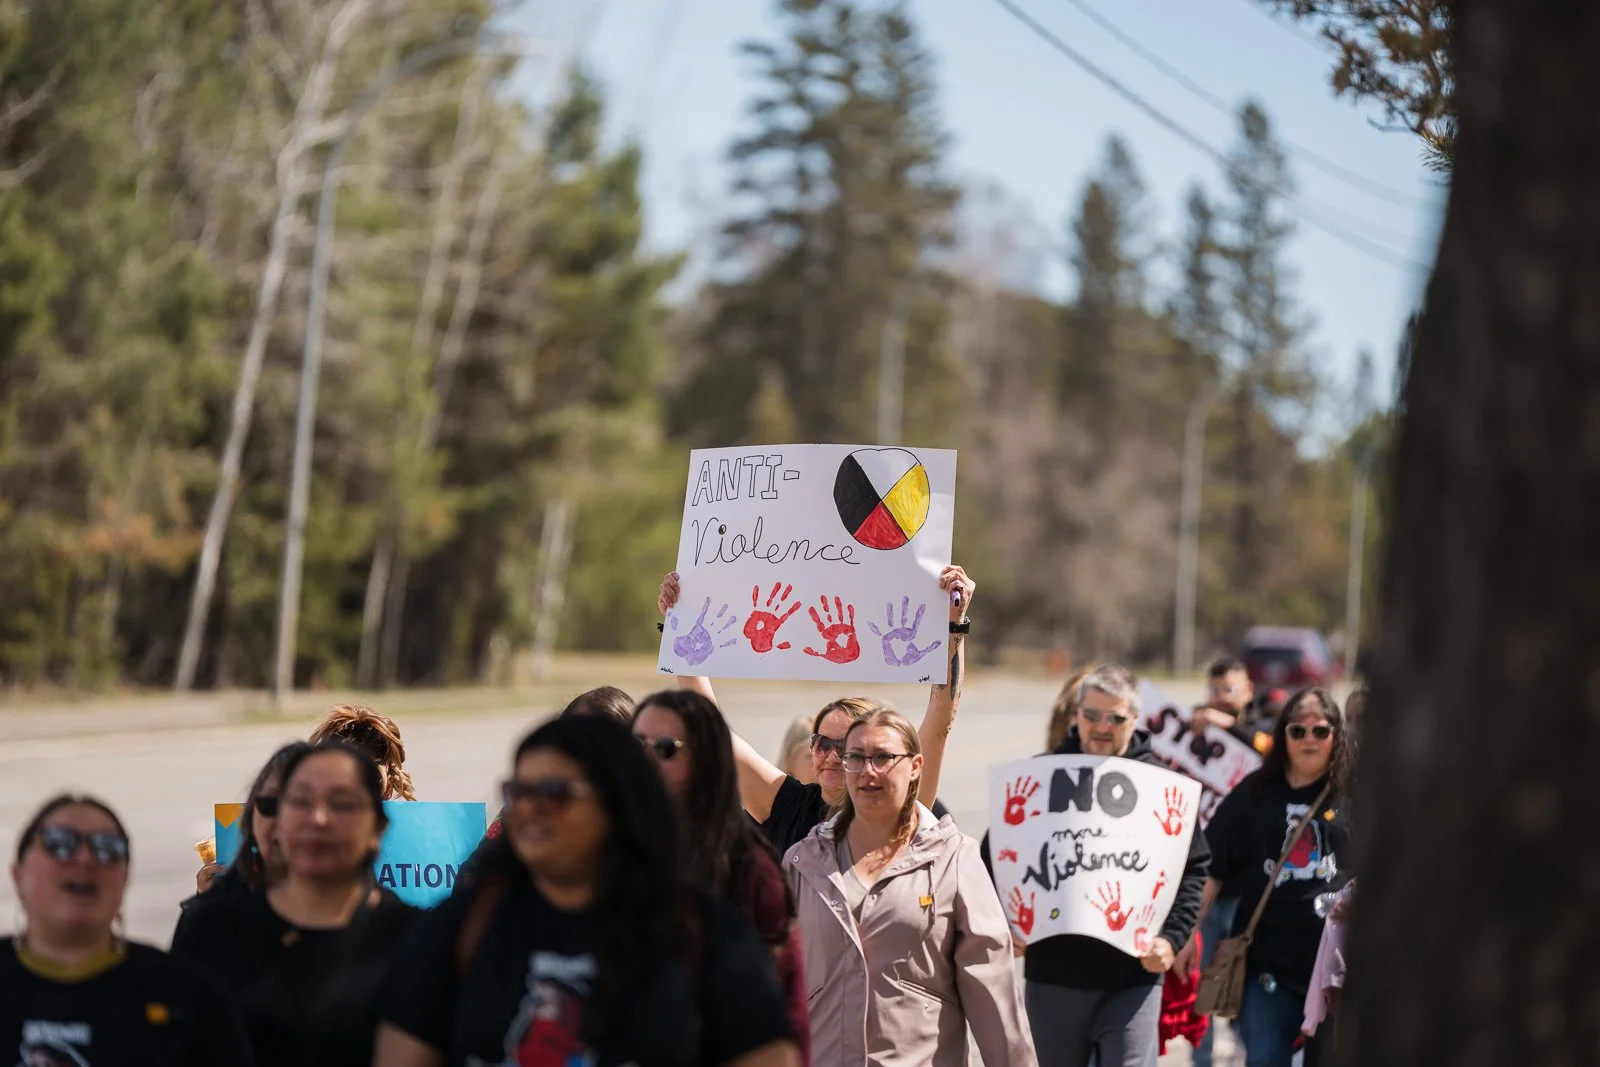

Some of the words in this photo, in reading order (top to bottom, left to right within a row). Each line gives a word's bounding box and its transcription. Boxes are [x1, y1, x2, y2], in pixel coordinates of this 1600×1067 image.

[692, 454, 800, 507] ANTI-
[691, 516, 860, 567] Violence
[1048, 767, 1138, 818] NO
[1052, 828, 1109, 842] more
[1022, 842, 1150, 892] Violence
